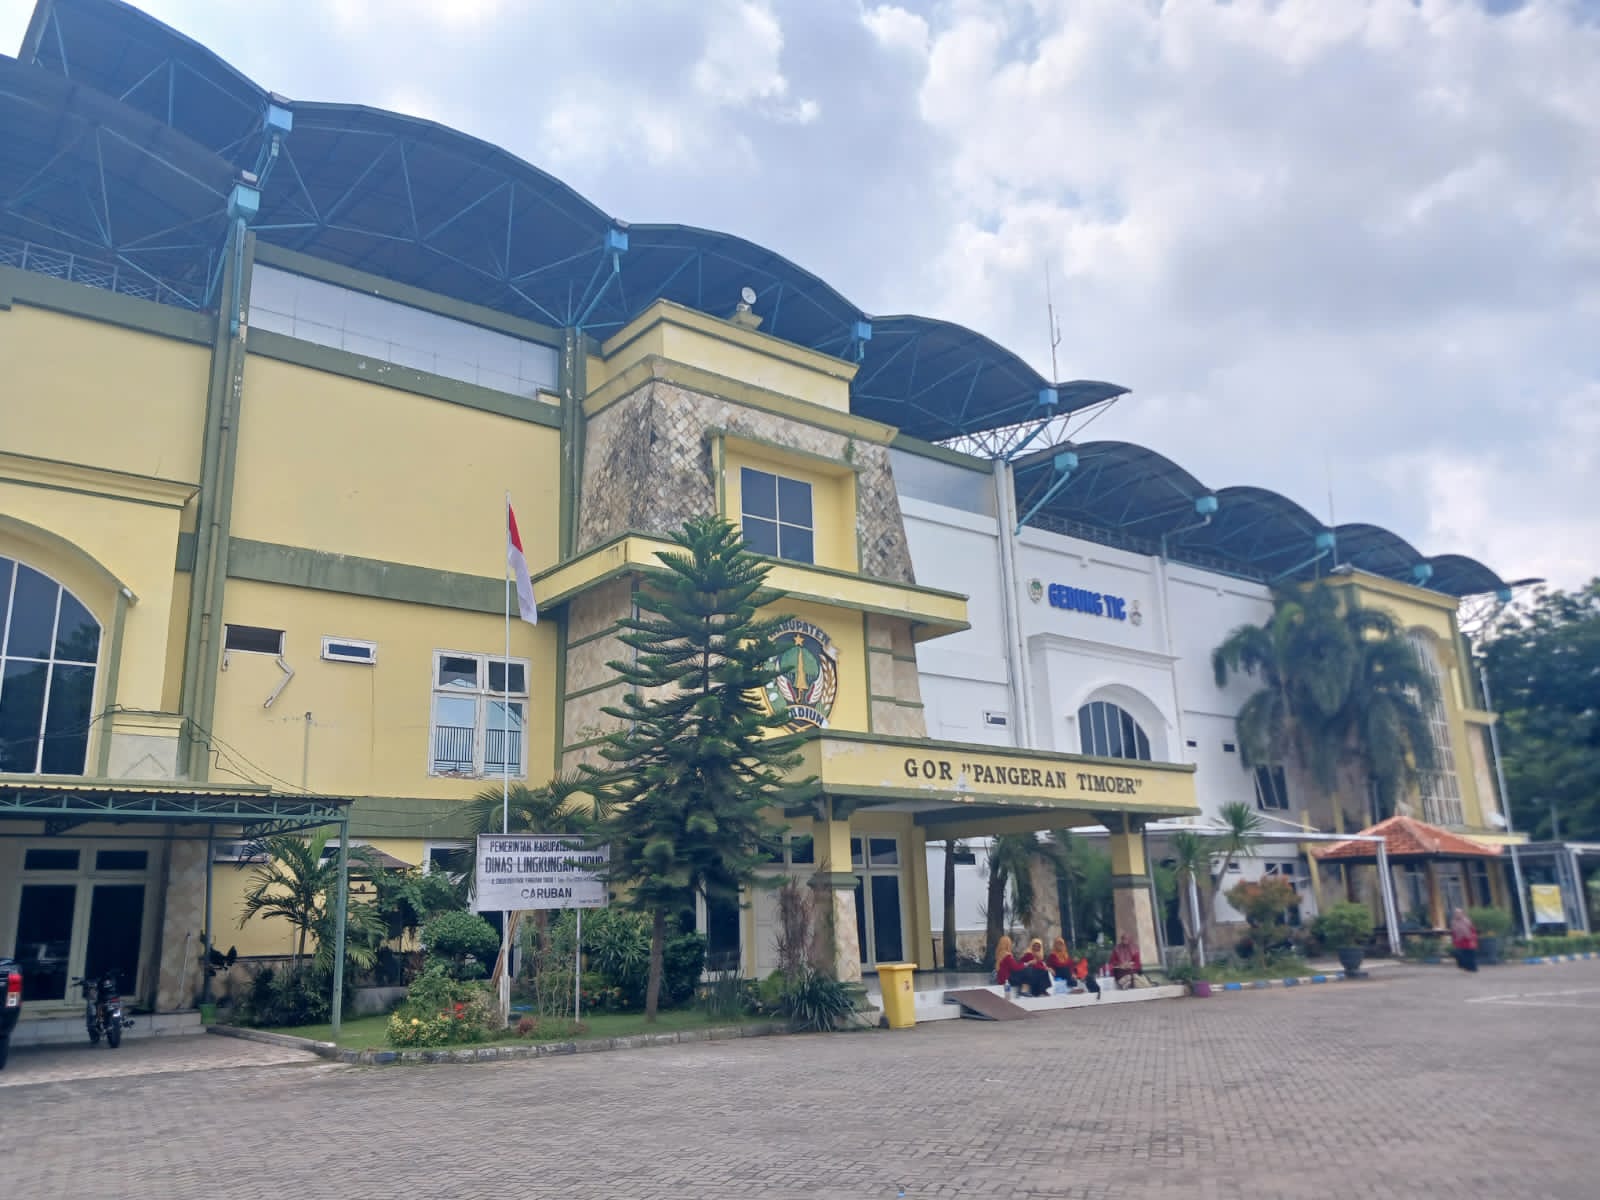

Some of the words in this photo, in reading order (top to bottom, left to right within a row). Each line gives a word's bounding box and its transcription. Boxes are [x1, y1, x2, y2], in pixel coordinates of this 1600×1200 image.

[1048, 582, 1103, 616] GEDUNG
[1103, 594, 1127, 621] TIC
[789, 706, 824, 725] ADIUN
[904, 758, 953, 780] GOR
[490, 839, 532, 852] PEMERINTAH
[485, 856, 513, 873] DINAS
[517, 856, 575, 873] LINGKUNGAN
[521, 887, 572, 899] CARUBAN
